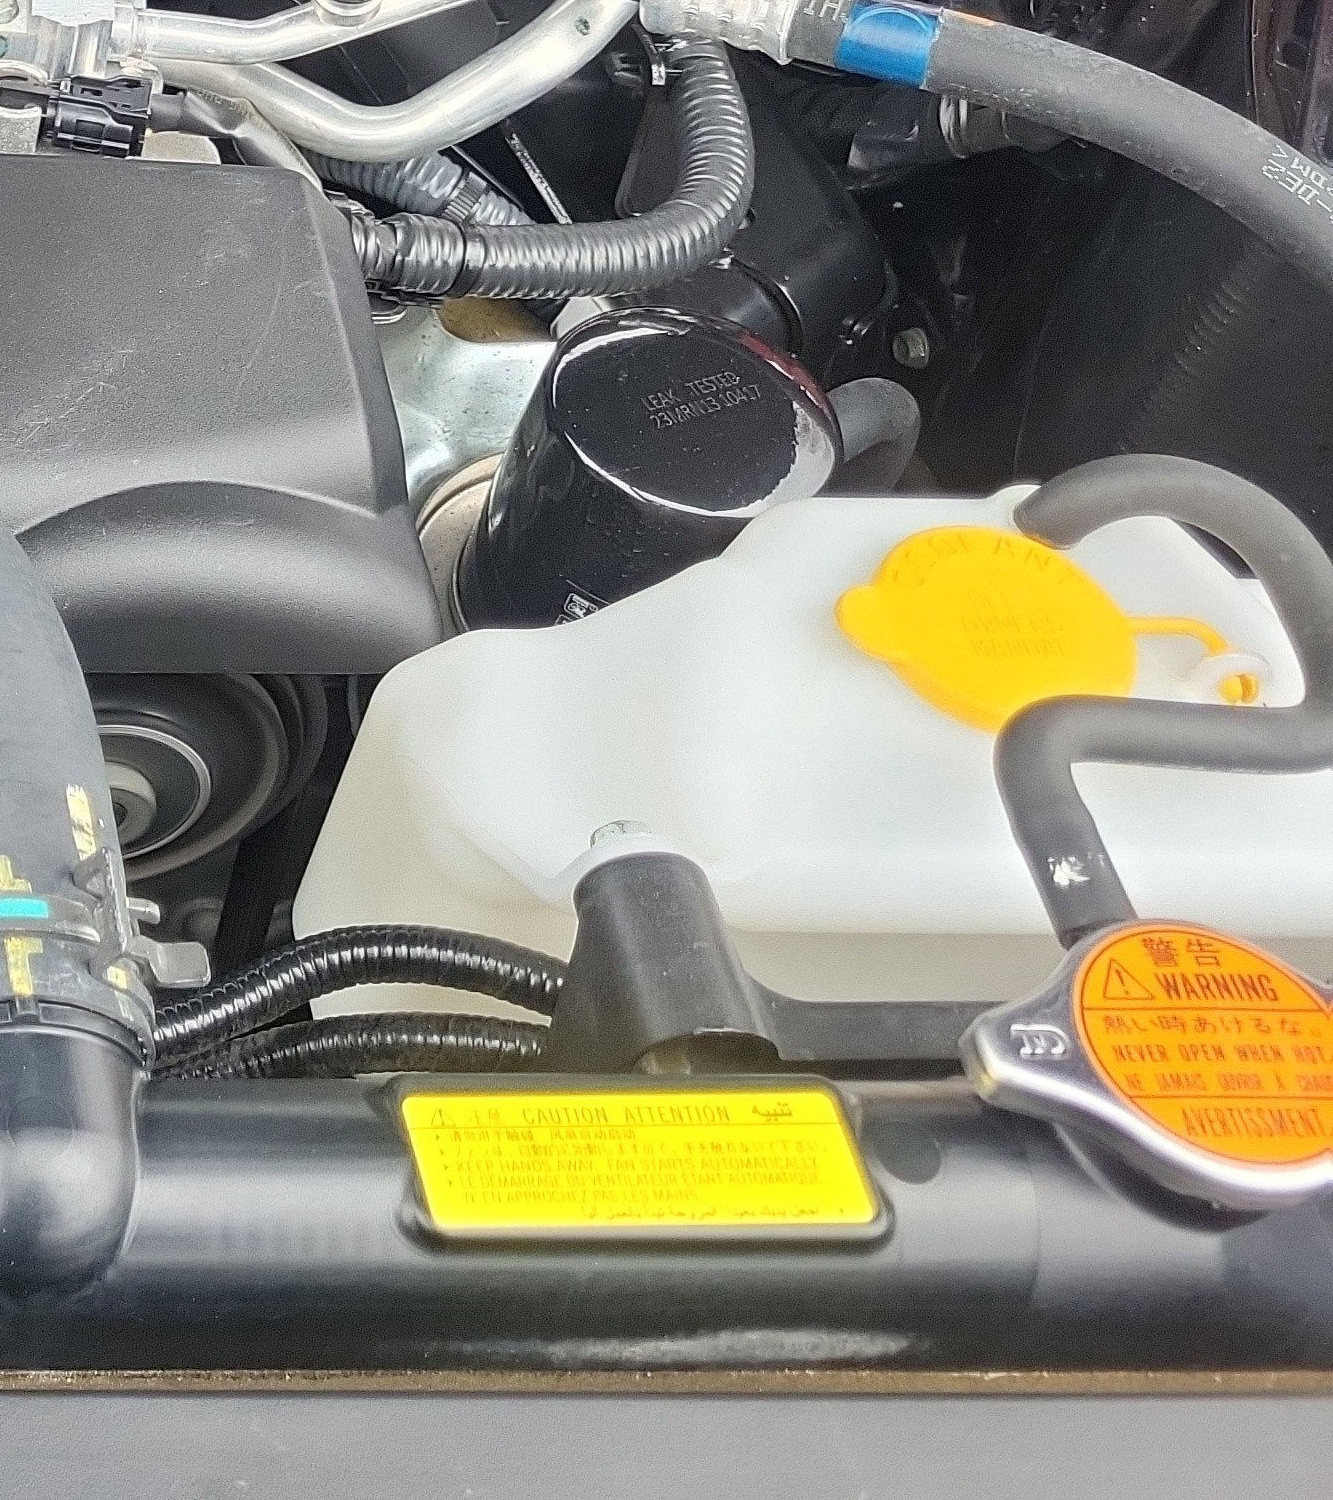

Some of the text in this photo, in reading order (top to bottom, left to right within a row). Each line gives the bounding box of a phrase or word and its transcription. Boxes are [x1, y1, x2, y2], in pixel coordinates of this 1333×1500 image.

[641, 371, 741, 411] LEAK TESTED
[1141, 937, 1221, 967] 警告
[1154, 972, 1279, 1001] WARNING
[1111, 1043, 1171, 1063] NEVER
[1177, 1043, 1227, 1062] OPEN
[1233, 1043, 1285, 1063] WHEN
[522, 1107, 609, 1125] CAUTION
[624, 1105, 730, 1124] ATTENTION
[457, 1159, 494, 1173] KEEP
[501, 1158, 552, 1172] HANDS
